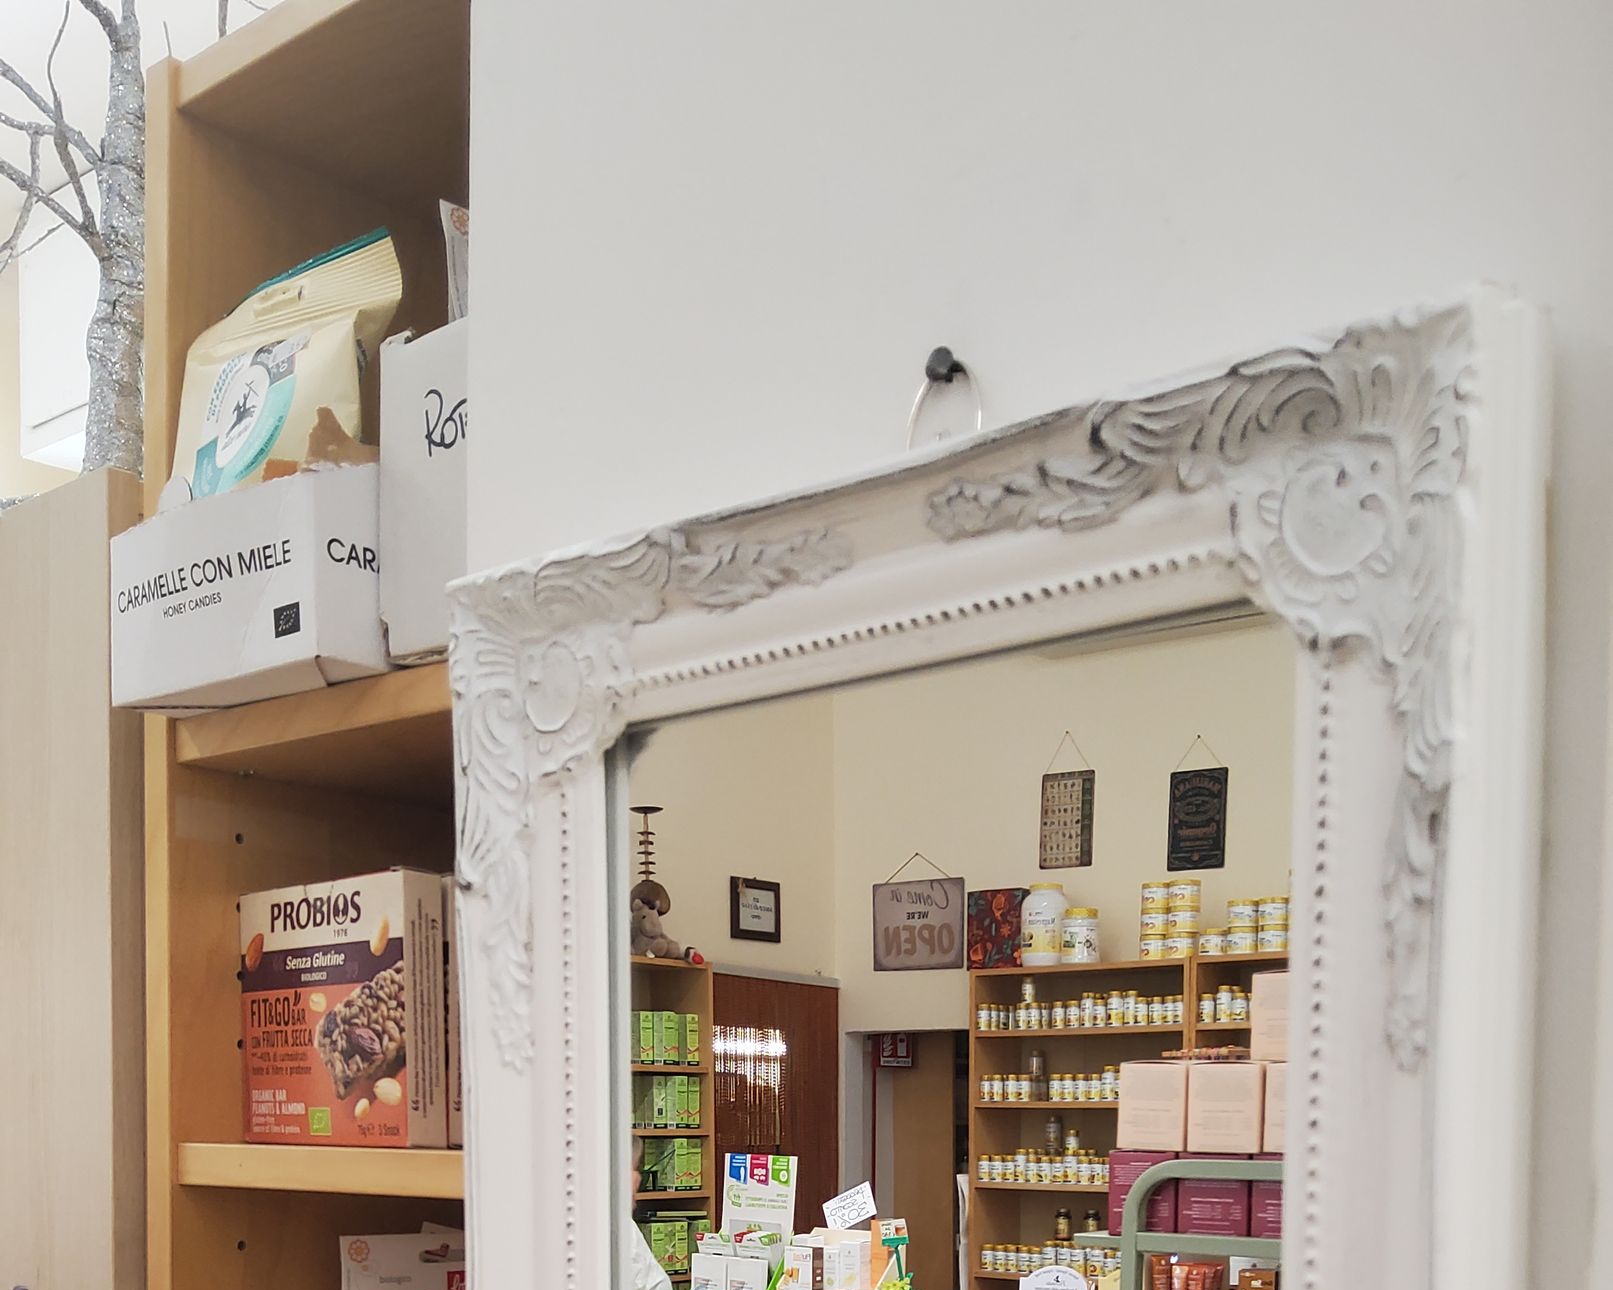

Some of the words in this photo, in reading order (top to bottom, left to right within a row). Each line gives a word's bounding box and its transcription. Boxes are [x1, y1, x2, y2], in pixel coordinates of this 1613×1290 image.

[118, 567, 188, 613] CARAMELLE
[190, 554, 233, 587] CON
[238, 539, 292, 576] MIELE
[163, 604, 187, 618] HONEY
[188, 592, 222, 611] CANDIES
[270, 890, 361, 933] PROBIOS
[286, 955, 311, 970] Senza
[313, 951, 345, 967] Glutine
[251, 996, 290, 1028] FIT&GO
[262, 1029, 289, 1049] FRUTTA
[291, 1028, 314, 1047] SECCA
